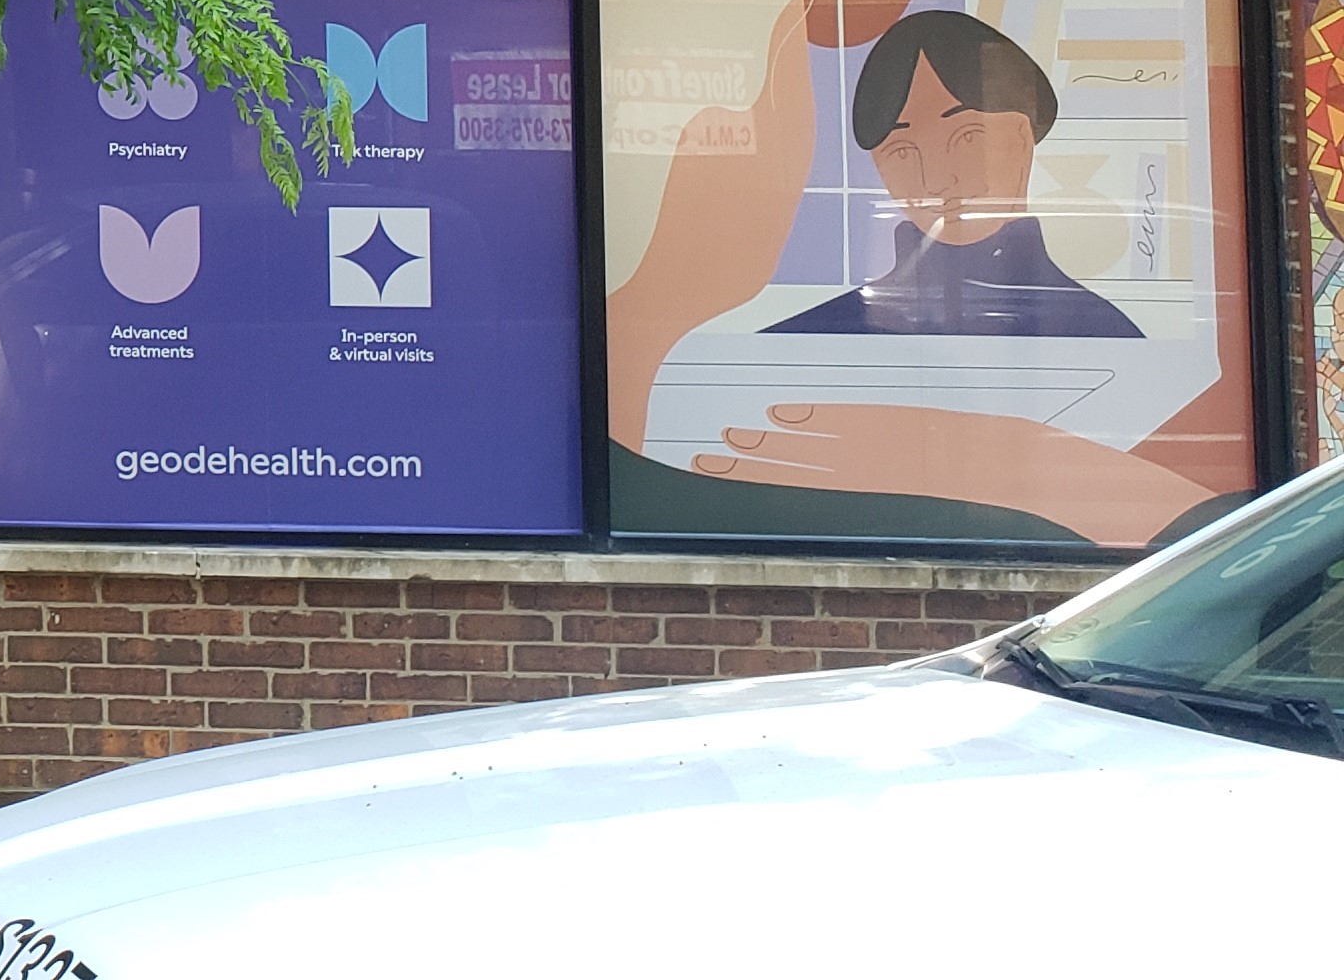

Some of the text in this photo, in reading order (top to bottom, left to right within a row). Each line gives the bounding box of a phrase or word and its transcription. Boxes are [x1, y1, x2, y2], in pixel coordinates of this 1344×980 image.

[109, 142, 188, 160] Psychiatry
[364, 144, 425, 162] therapy
[110, 325, 188, 340] Advanced
[341, 328, 418, 346] In-person
[109, 344, 195, 359] treatments
[329, 347, 435, 362] & virtual visits
[115, 445, 422, 480] geodehealth.com
